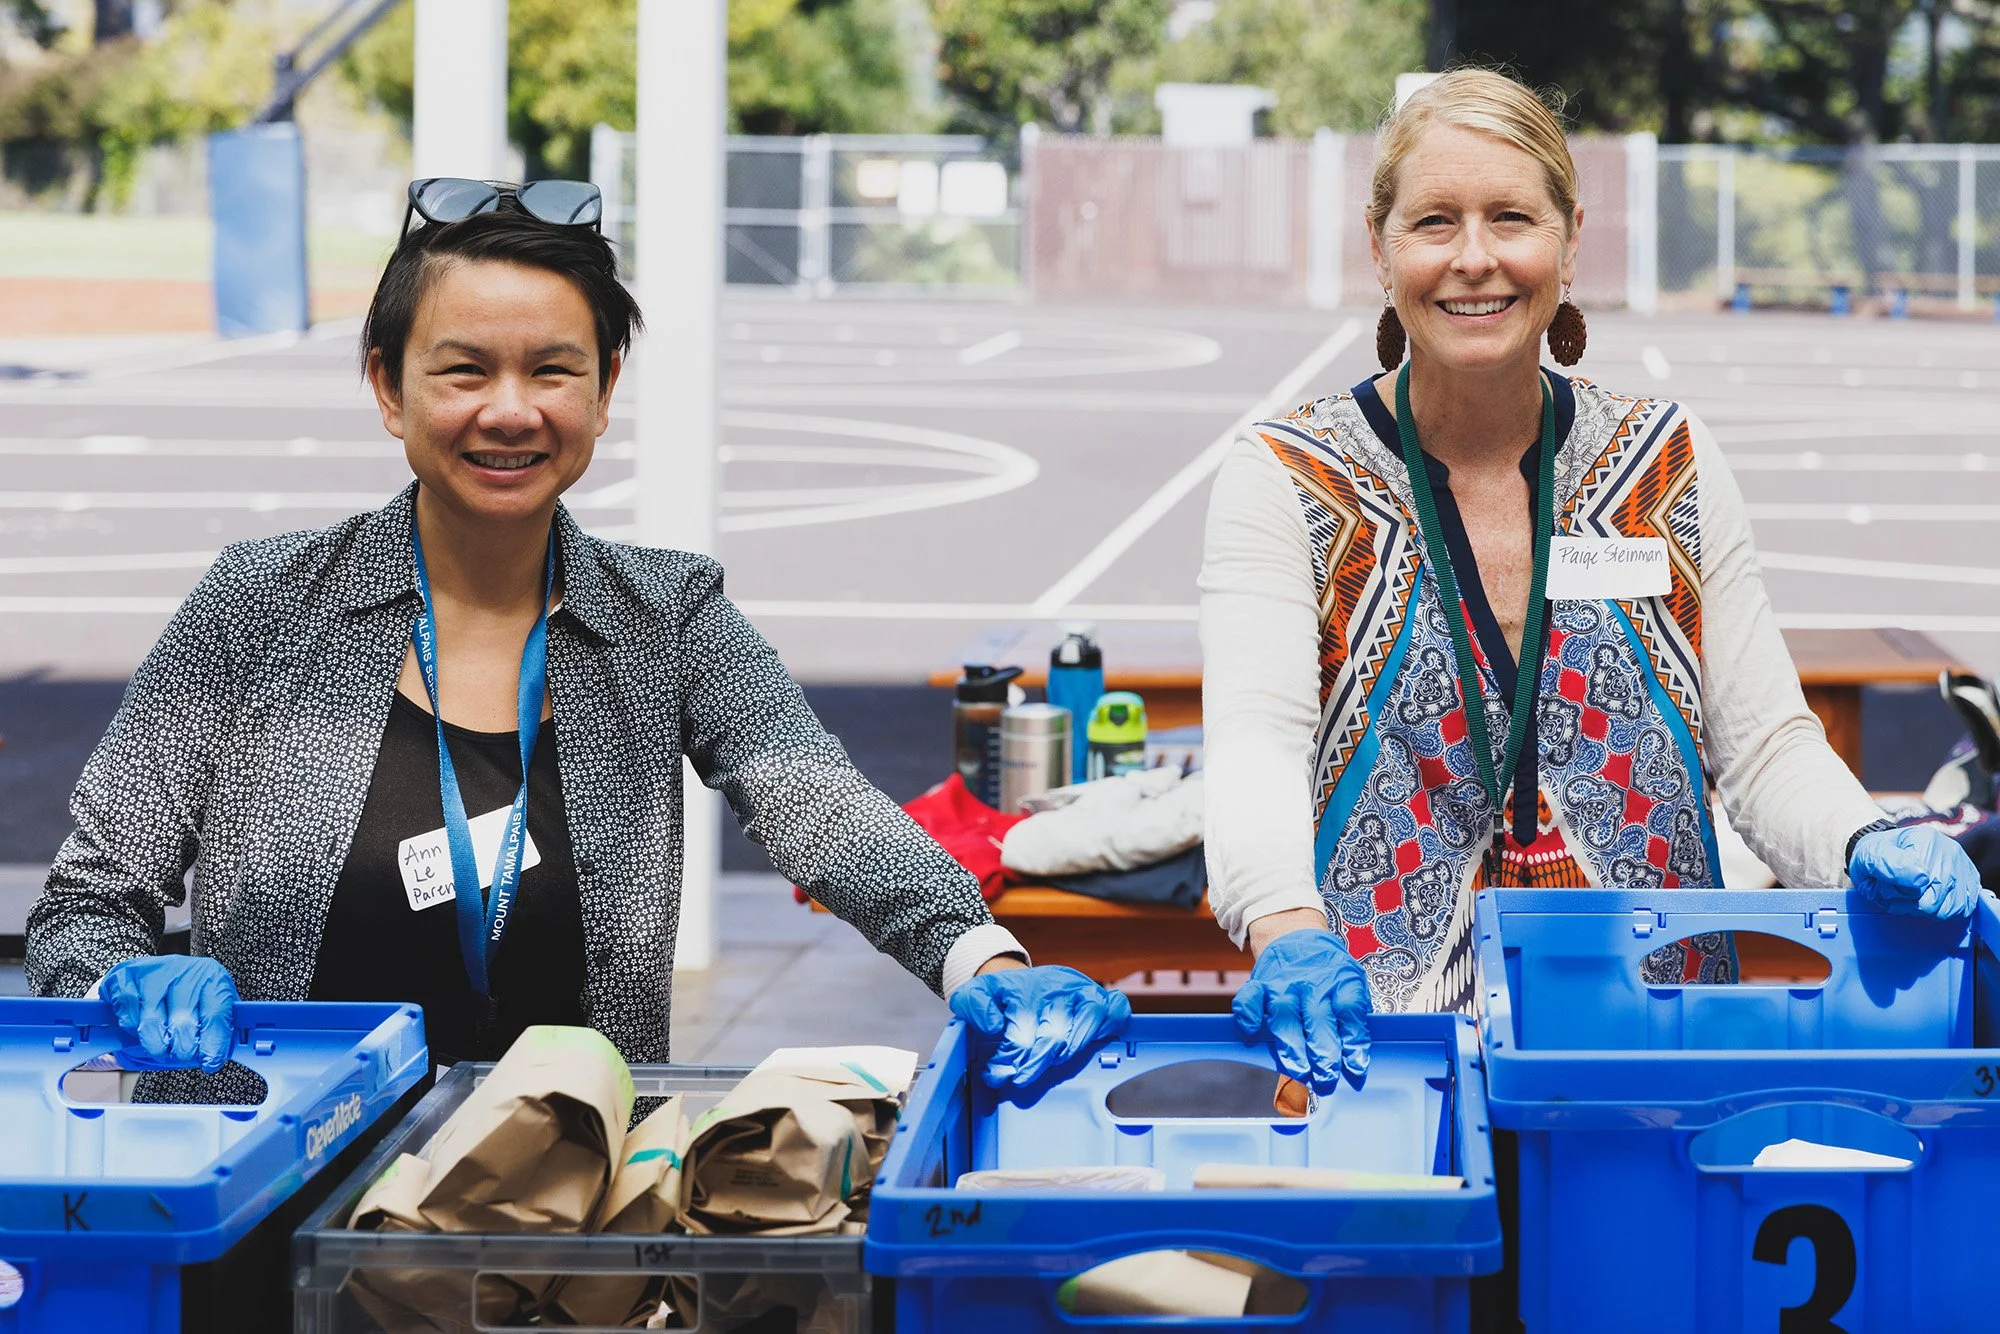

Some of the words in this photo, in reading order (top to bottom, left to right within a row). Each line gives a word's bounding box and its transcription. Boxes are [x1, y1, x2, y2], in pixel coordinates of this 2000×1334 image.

[1559, 544, 1598, 570] Paige
[1603, 543, 1663, 563] Steinman
[404, 844, 442, 866] Ann
[414, 866, 435, 882] Le
[491, 888, 511, 941] MOUNT
[501, 812, 522, 885] TAMALPAIS
[412, 882, 455, 904] Paren
[306, 1092, 362, 1160] CleverMade
[63, 1191, 91, 1231] K
[925, 1200, 982, 1237] 2nd
[1752, 1204, 1858, 1334] 3
